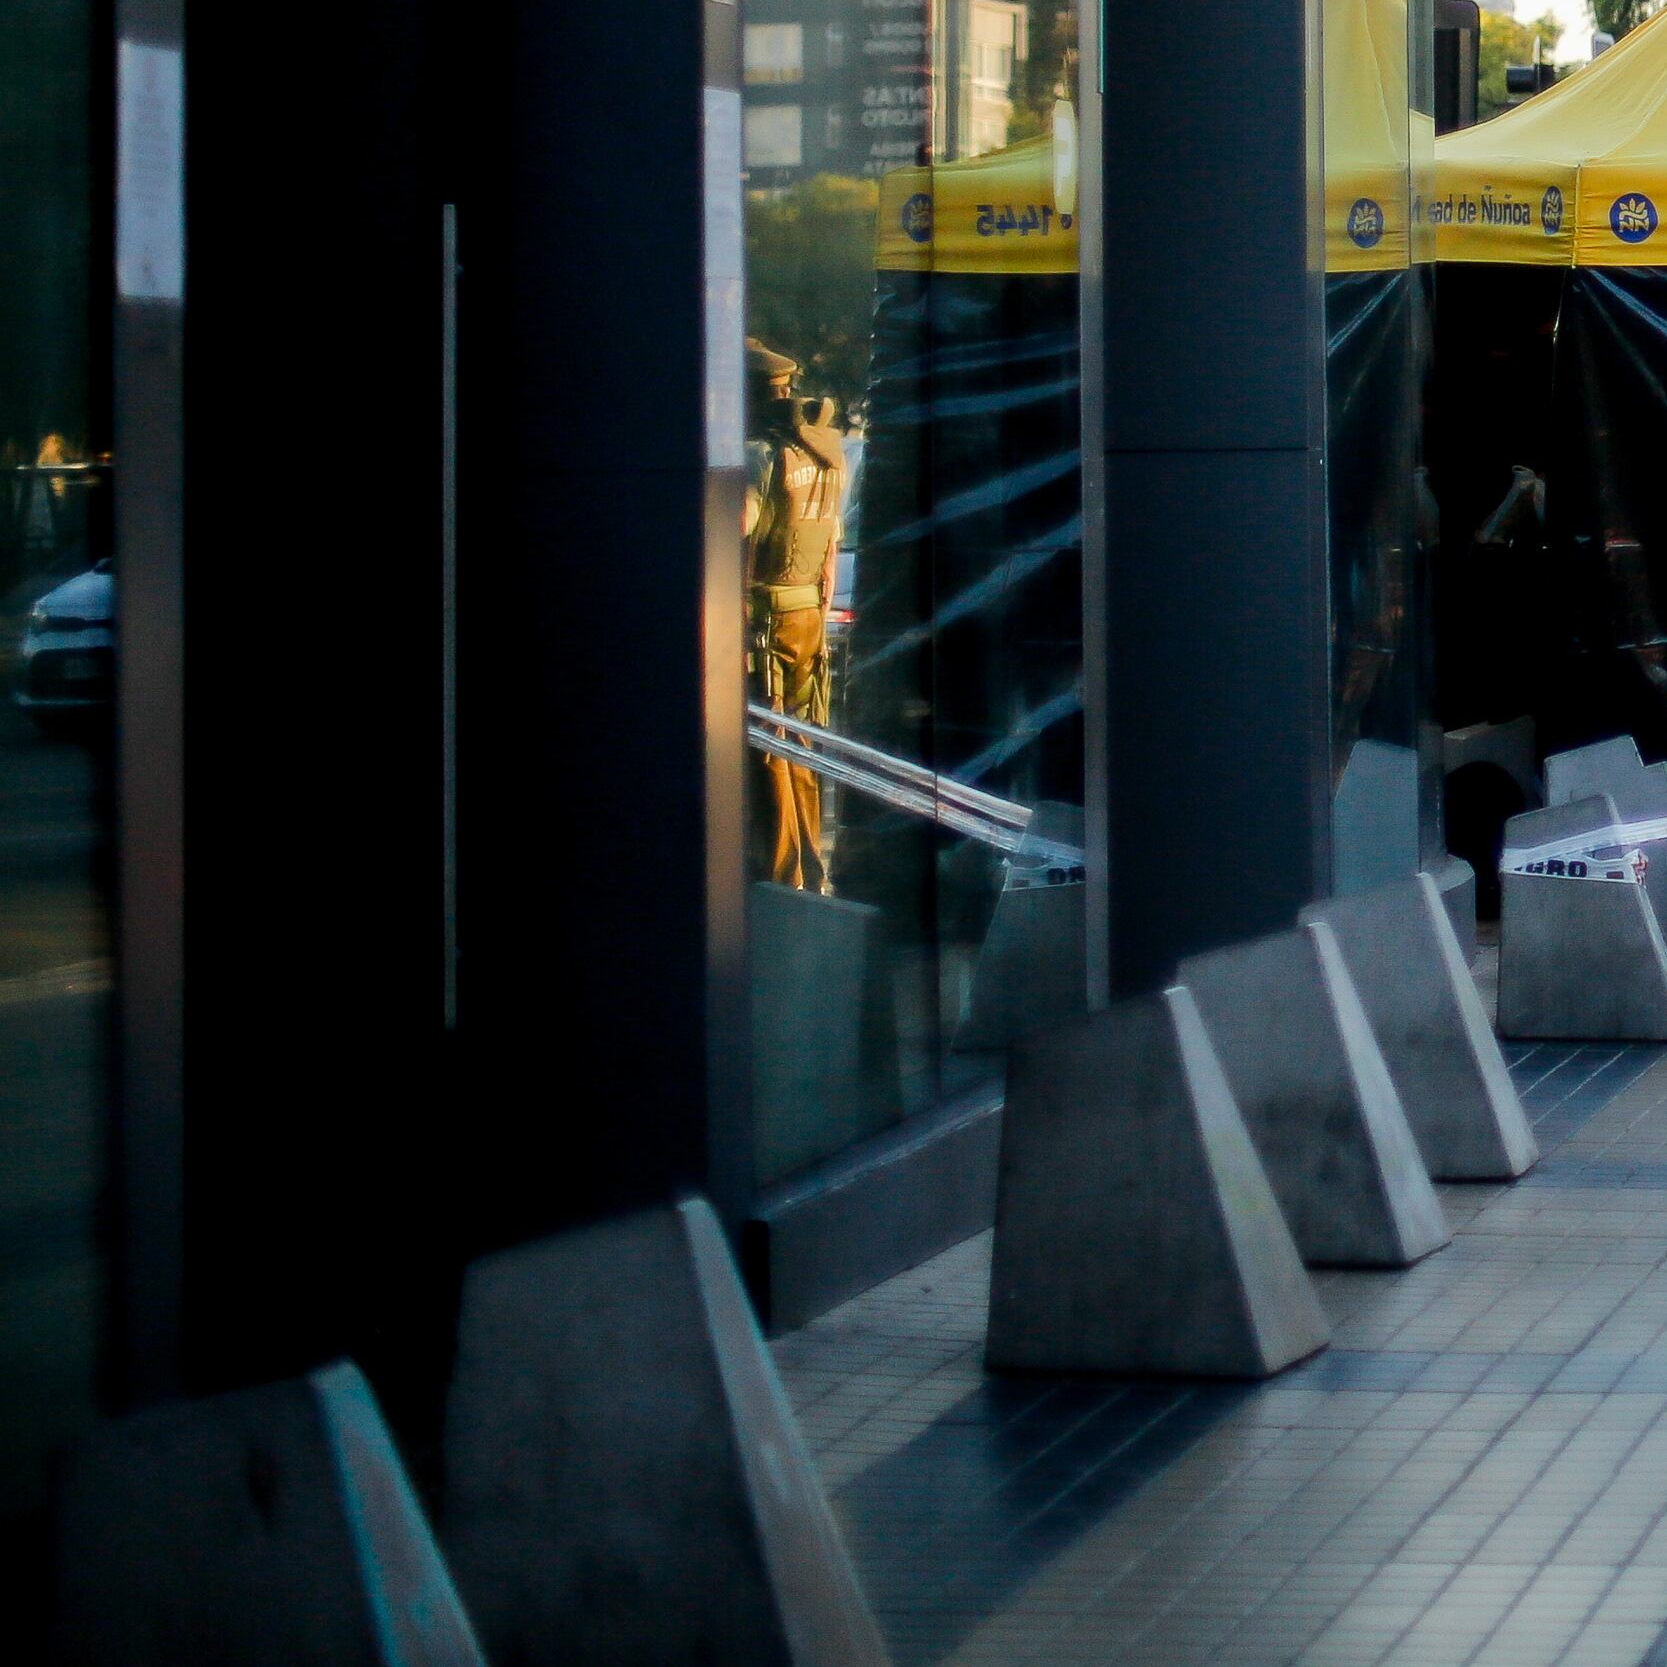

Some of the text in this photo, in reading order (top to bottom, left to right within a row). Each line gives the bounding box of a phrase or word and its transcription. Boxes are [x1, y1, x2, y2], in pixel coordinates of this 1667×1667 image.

[1457, 194, 1477, 224] de
[1480, 185, 1531, 226] Ñuñoa
[1514, 859, 1588, 879] GRO
